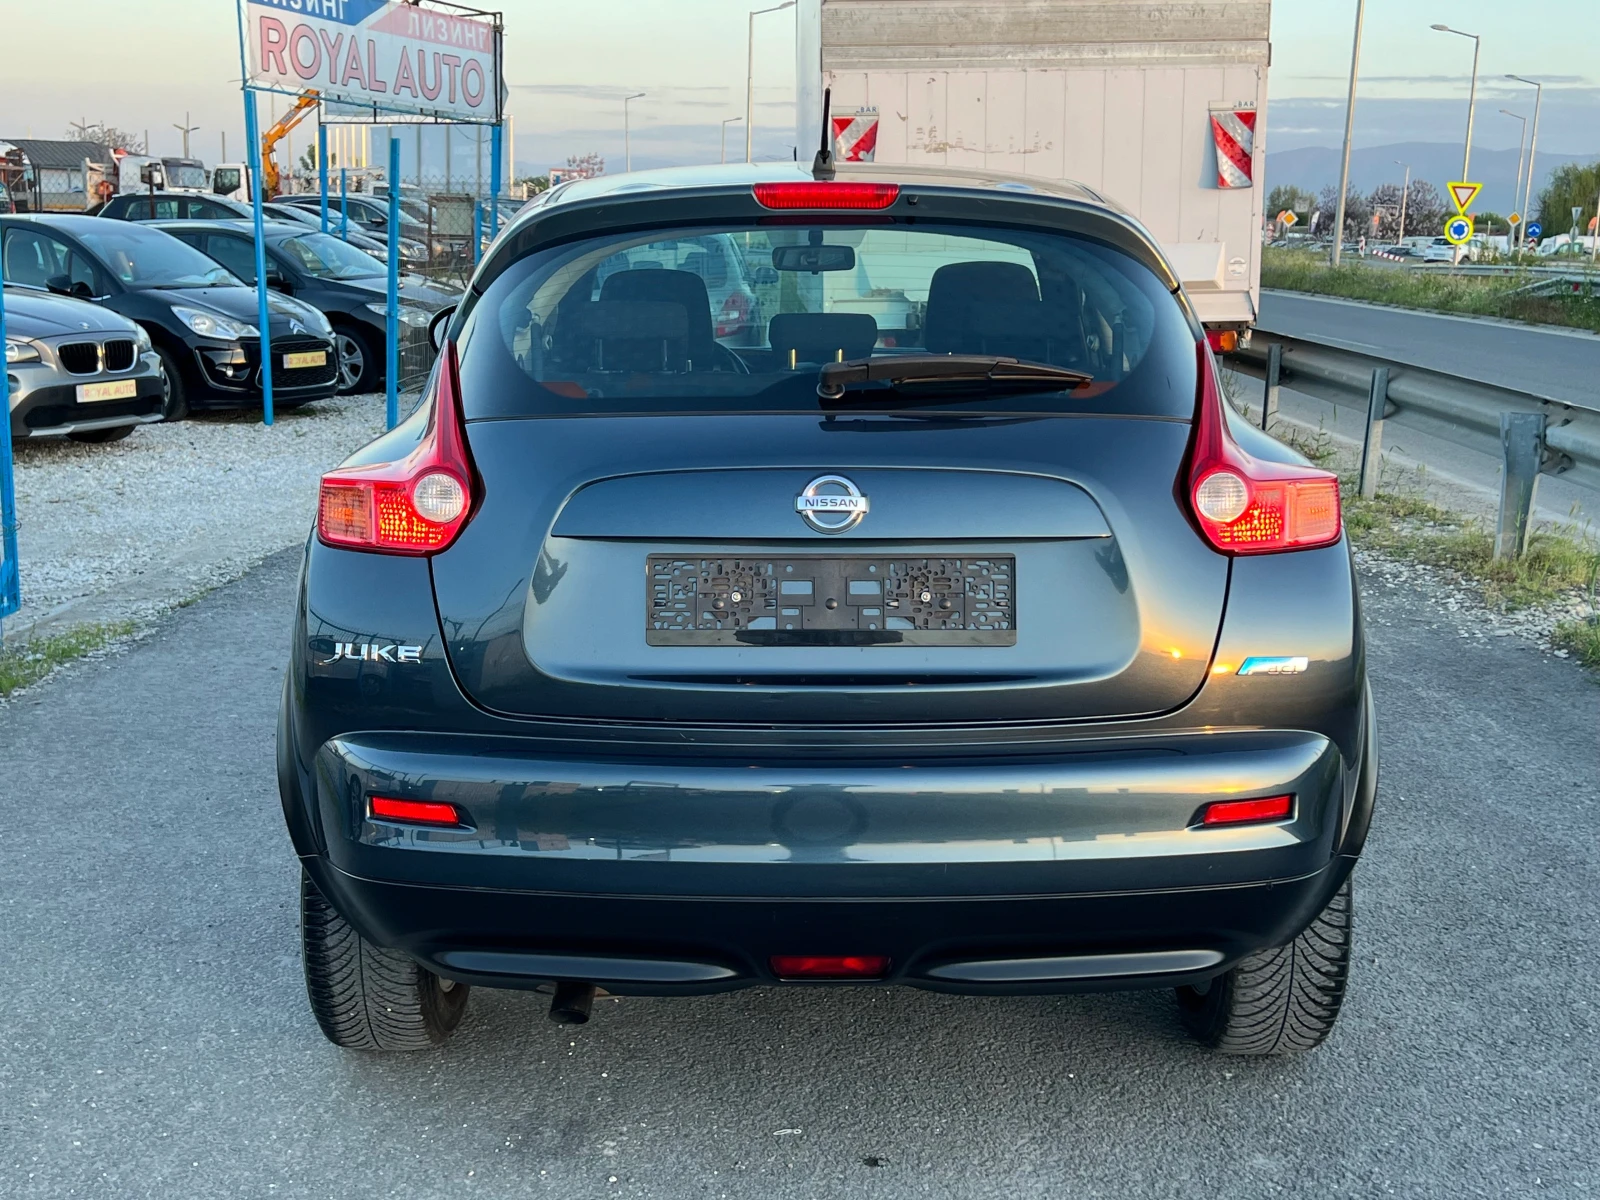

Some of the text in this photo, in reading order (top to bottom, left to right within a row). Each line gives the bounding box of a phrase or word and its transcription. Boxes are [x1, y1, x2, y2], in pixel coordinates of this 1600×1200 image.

[263, 0, 348, 20] ЗИНГ
[407, 11, 488, 48] ЛИЗИНГ
[259, 15, 485, 108] ROYAL AUTO
[114, 383, 135, 396] AUTO
[805, 498, 858, 507] NISSAN
[321, 642, 422, 665] JUKE
